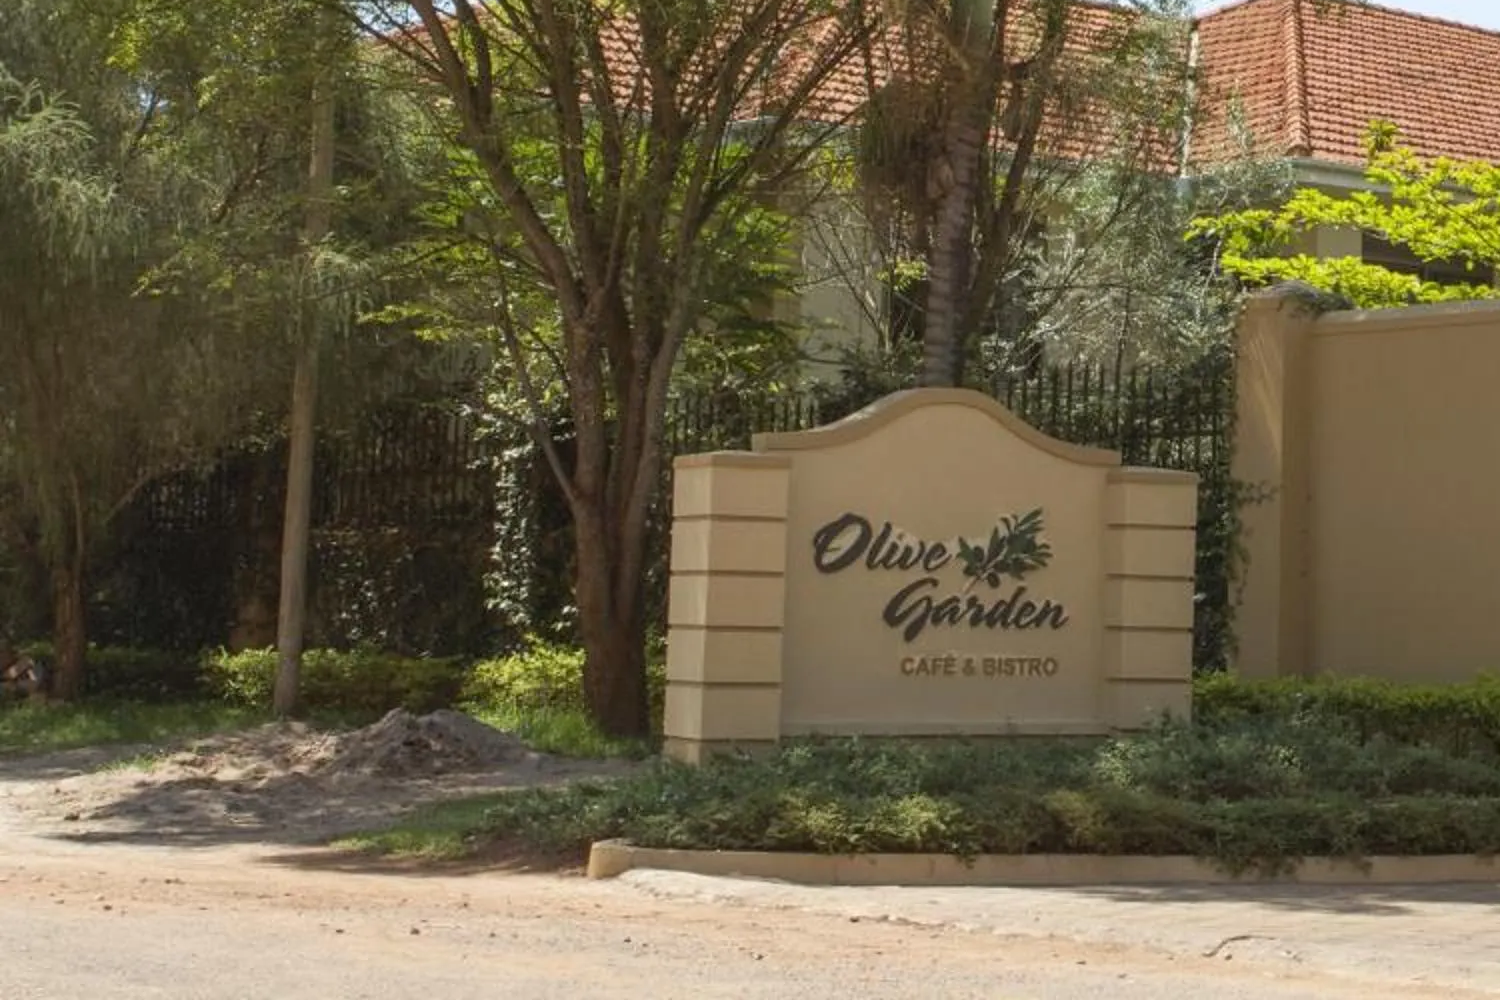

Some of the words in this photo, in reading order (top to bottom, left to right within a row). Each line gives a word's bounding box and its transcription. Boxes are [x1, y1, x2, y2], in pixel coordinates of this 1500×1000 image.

[813, 512, 953, 574] Olive
[882, 577, 1069, 643] Garden
[901, 653, 956, 676] CAFÉ
[962, 657, 978, 676] &
[982, 657, 1058, 676] BISTRO
